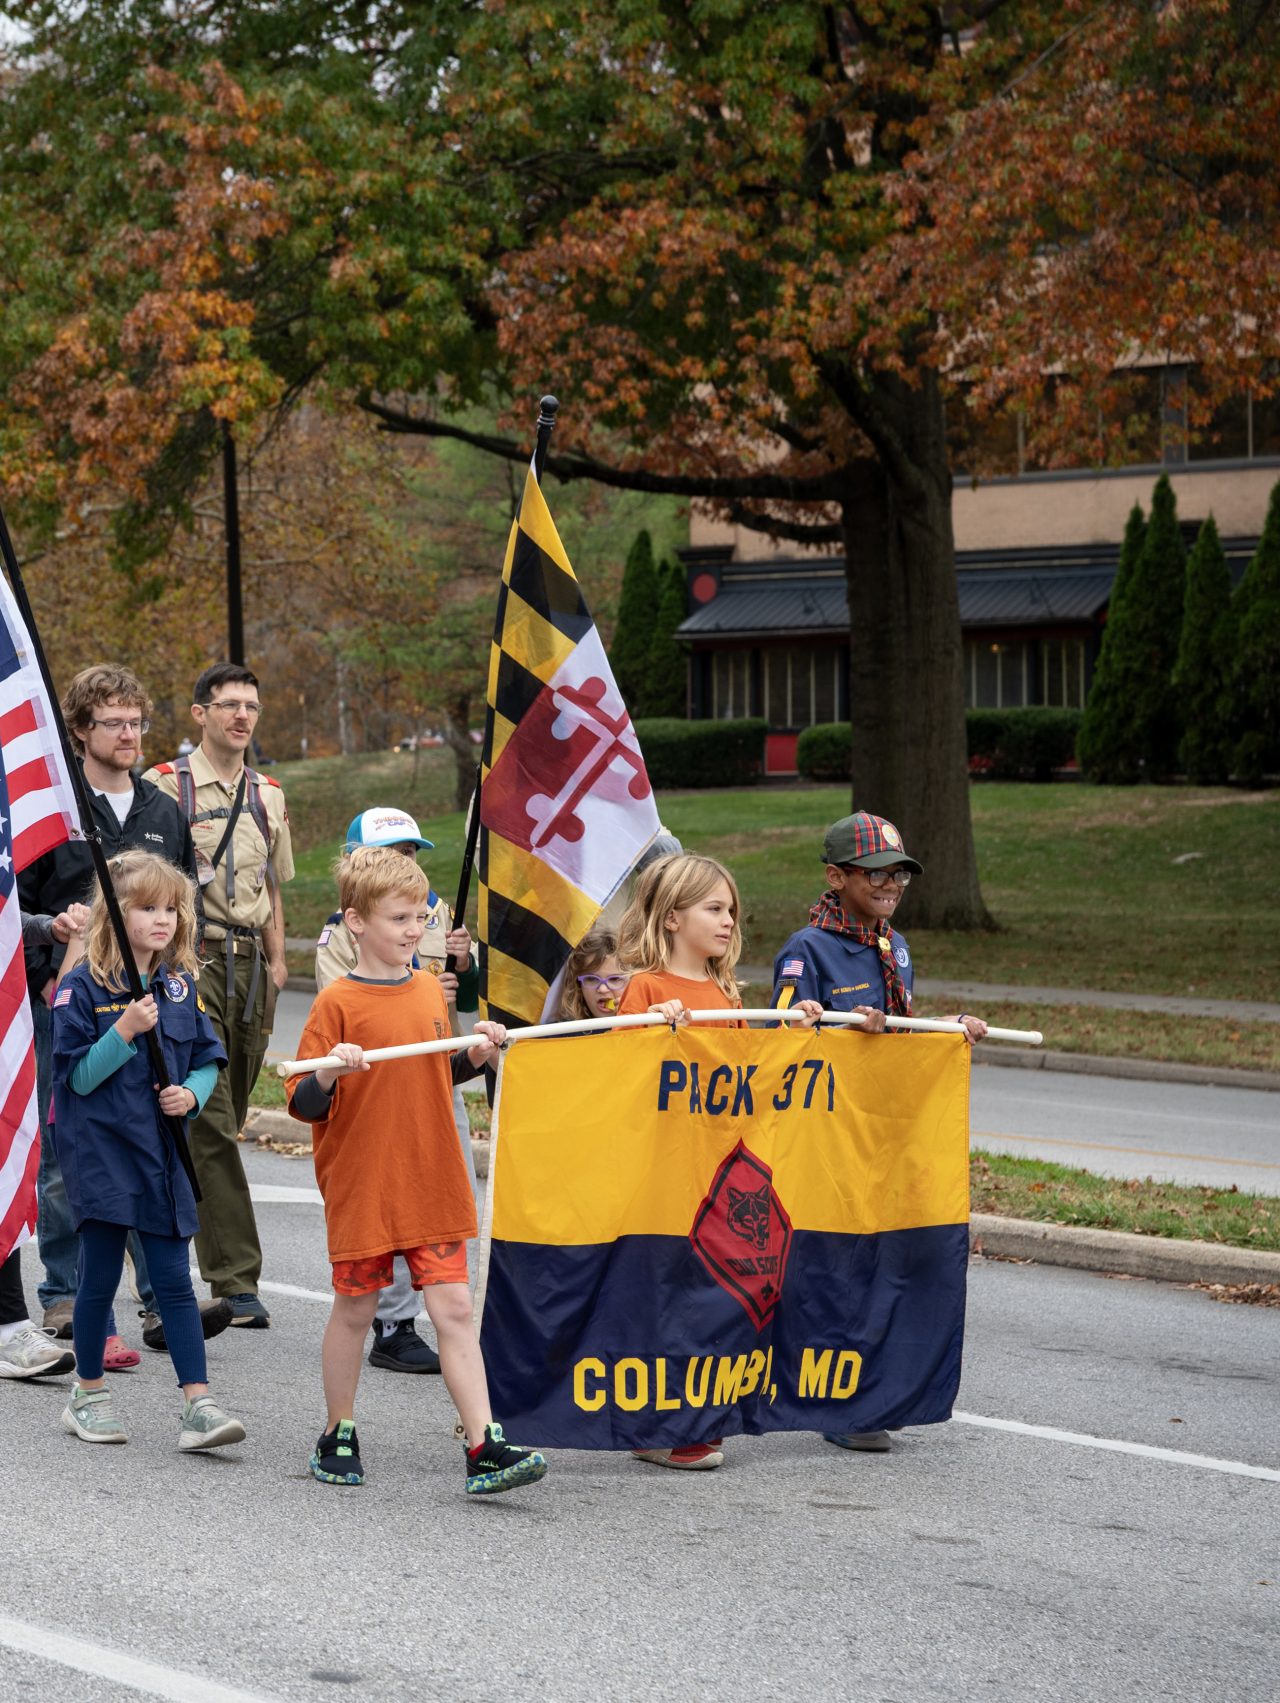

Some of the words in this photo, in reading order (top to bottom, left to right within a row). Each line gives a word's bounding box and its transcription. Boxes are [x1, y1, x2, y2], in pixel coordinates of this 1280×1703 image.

[658, 1060, 759, 1117] PACK
[772, 1060, 835, 1112] 371
[573, 1345, 777, 1412] COLUMB,
[798, 1347, 863, 1400] MD
